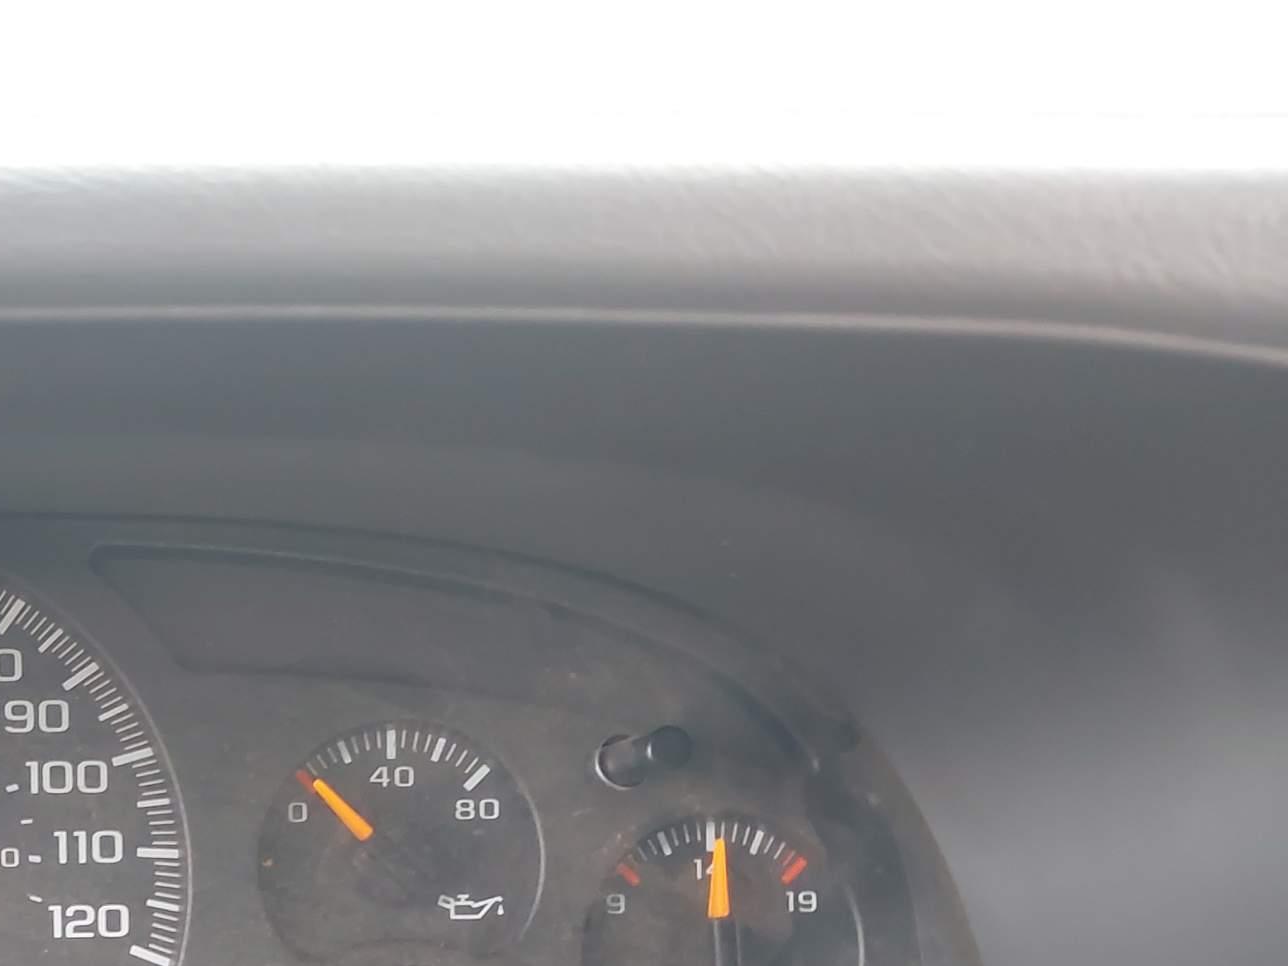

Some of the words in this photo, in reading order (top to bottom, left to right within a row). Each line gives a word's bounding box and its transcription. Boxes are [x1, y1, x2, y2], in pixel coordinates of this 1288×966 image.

[4, 700, 70, 733] 90
[25, 760, 109, 795] 100
[369, 765, 414, 788] 40
[288, 801, 308, 823] 0
[454, 798, 500, 820] 80
[53, 830, 124, 864] 110
[605, 893, 626, 915] 9
[785, 891, 818, 913] 19
[47, 904, 130, 939] 120
